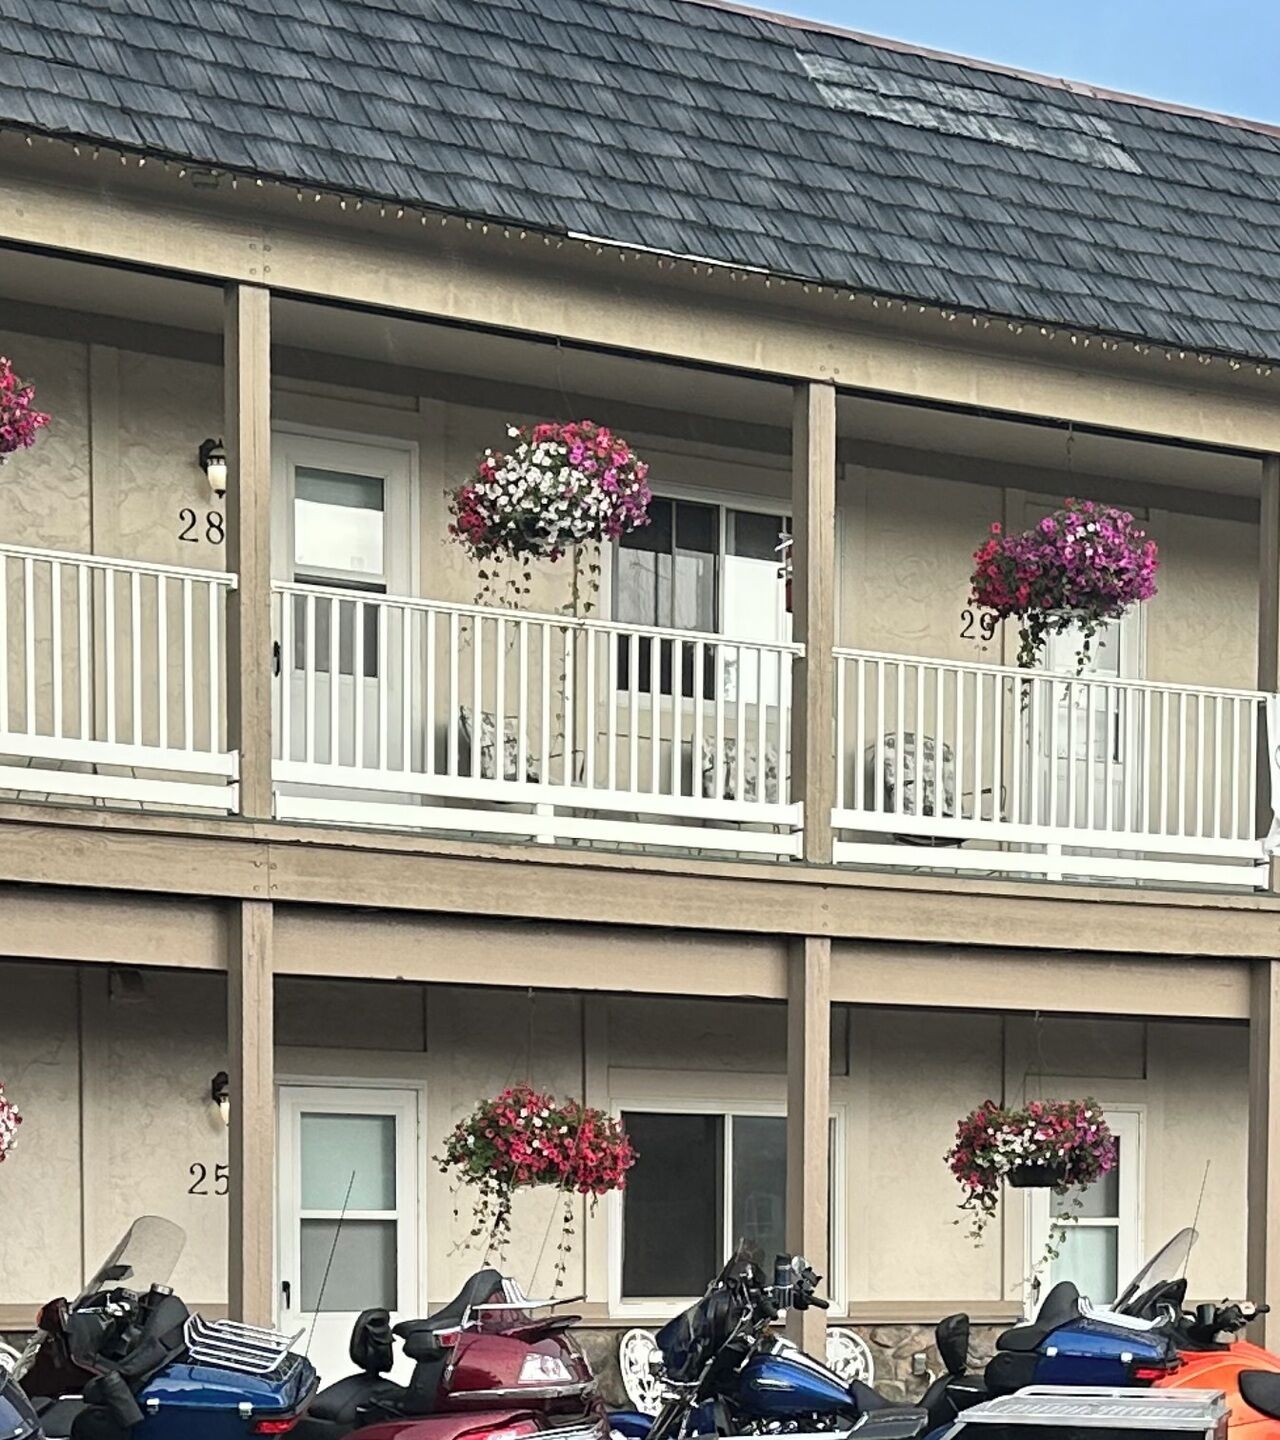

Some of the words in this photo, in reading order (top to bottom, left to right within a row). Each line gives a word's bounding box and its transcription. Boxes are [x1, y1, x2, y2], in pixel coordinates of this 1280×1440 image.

[178, 508, 225, 545] 28
[960, 609, 996, 641] 29
[188, 1162, 230, 1196] 25
